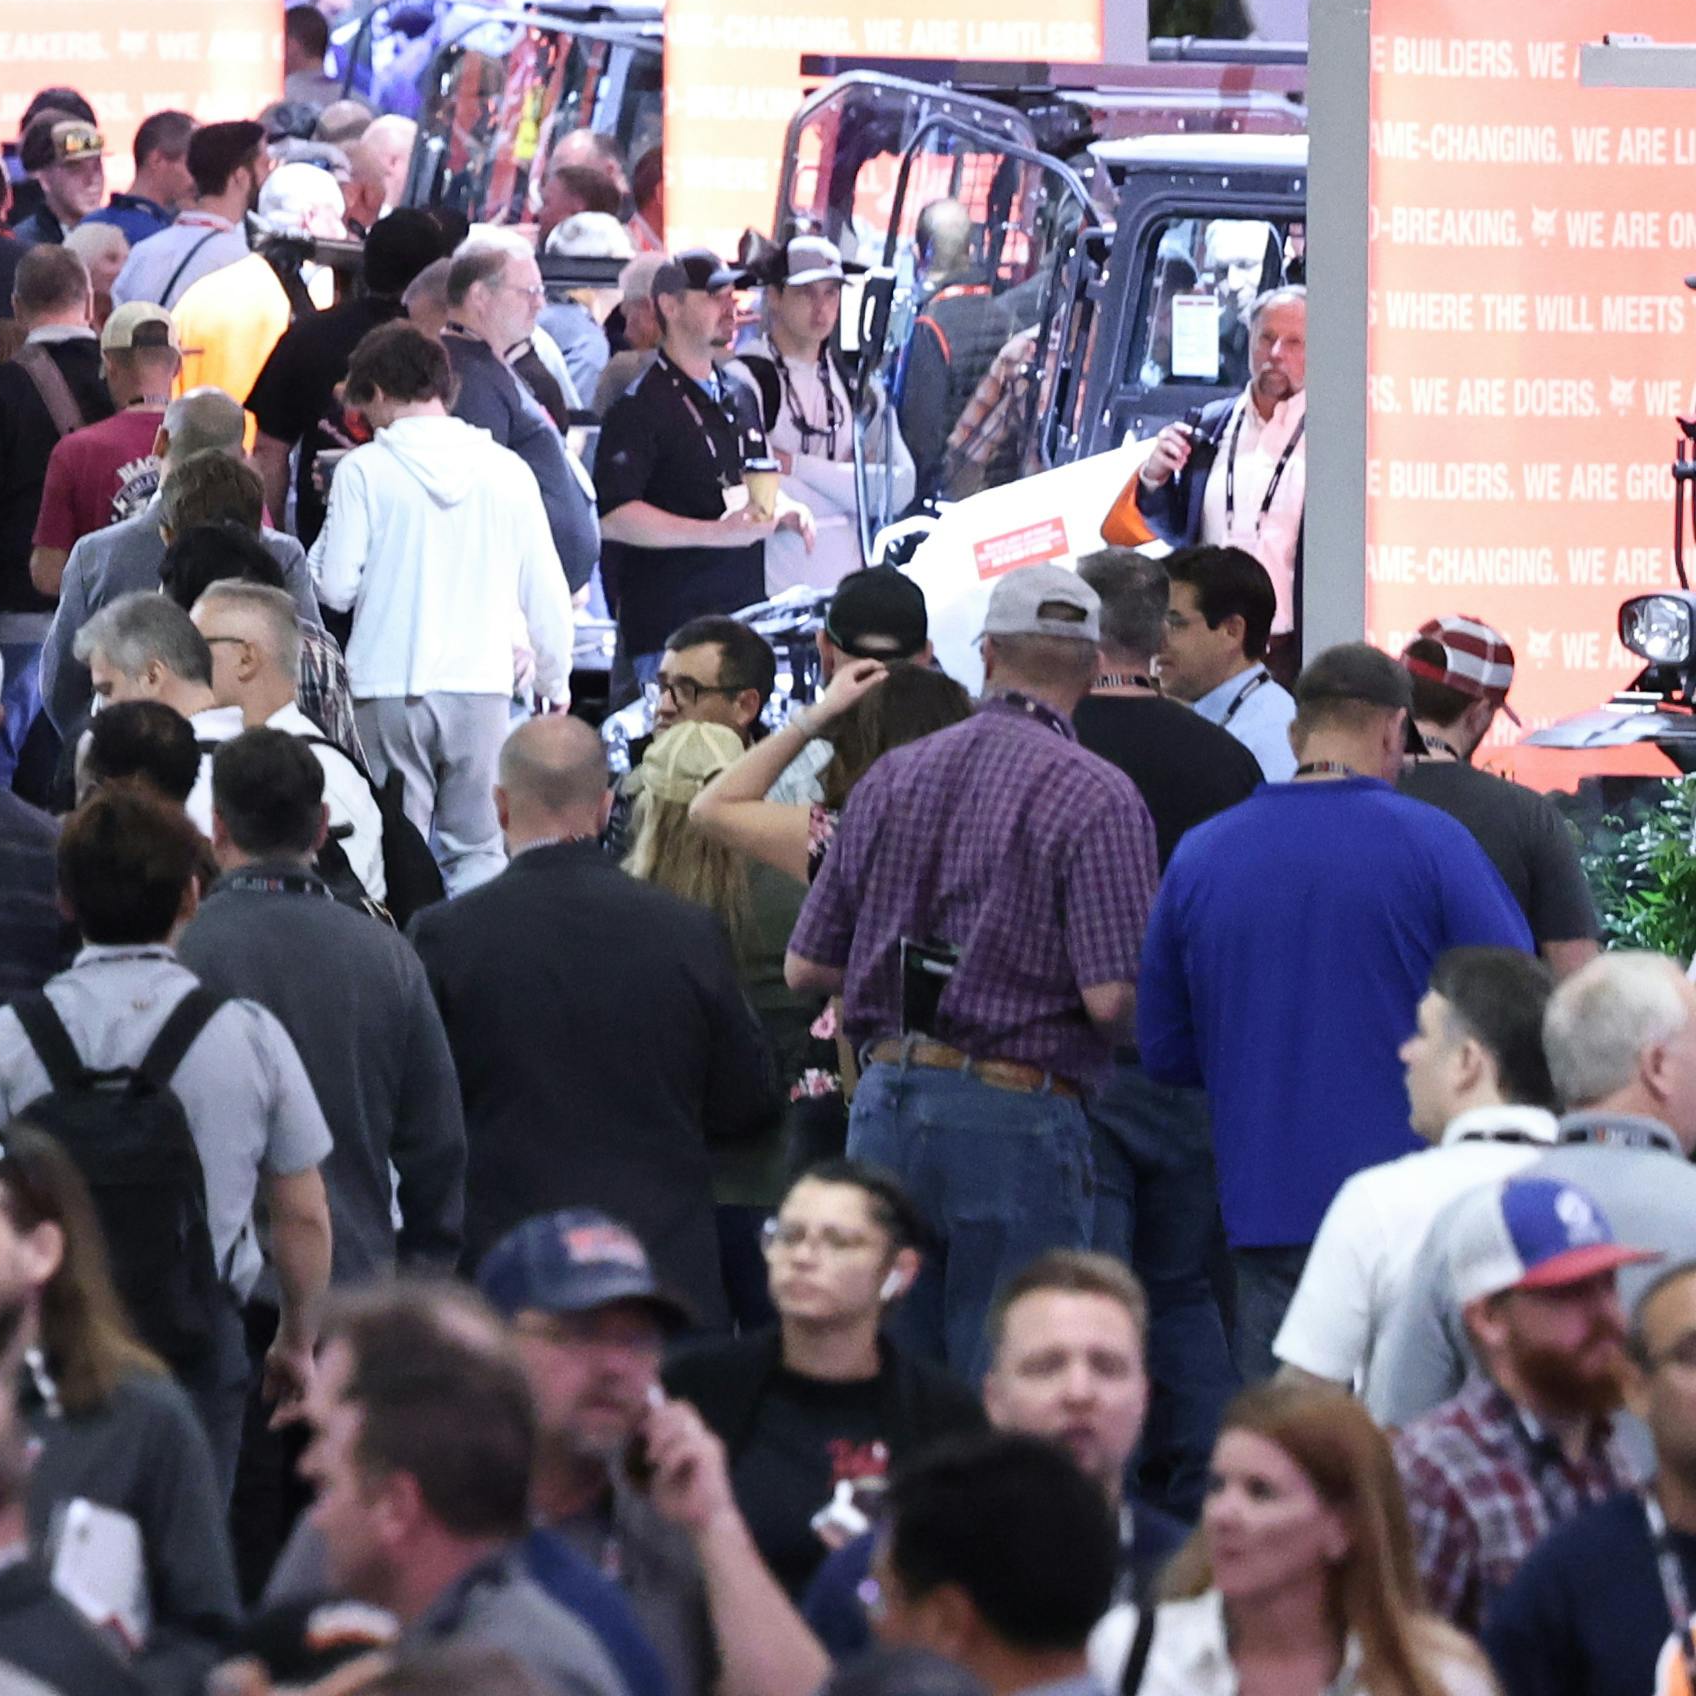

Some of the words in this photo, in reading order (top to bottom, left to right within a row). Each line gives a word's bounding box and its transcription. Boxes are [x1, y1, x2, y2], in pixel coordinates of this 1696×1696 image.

[1393, 37, 1520, 79] BUILDERS.
[1527, 42, 1566, 80] WE
[1571, 126, 1611, 165] WE
[1618, 128, 1667, 166] ARE
[1566, 210, 1605, 248] WE
[1611, 211, 1660, 249] ARE
[1386, 291, 1473, 331] WHERE
[1481, 293, 1527, 331] THE
[1535, 295, 1594, 333] WILL
[1601, 296, 1685, 333] MEETS
[1411, 377, 1449, 416] WE
[1458, 378, 1506, 416] ARE
[1514, 380, 1601, 417] DOERS.
[1644, 381, 1682, 416] WE
[1389, 461, 1515, 500] BUILDERS.
[1523, 463, 1562, 501] WE
[1568, 464, 1619, 501] ARE
[1567, 548, 1607, 586] WE
[1613, 548, 1662, 586] ARE
[1563, 631, 1601, 670] WE
